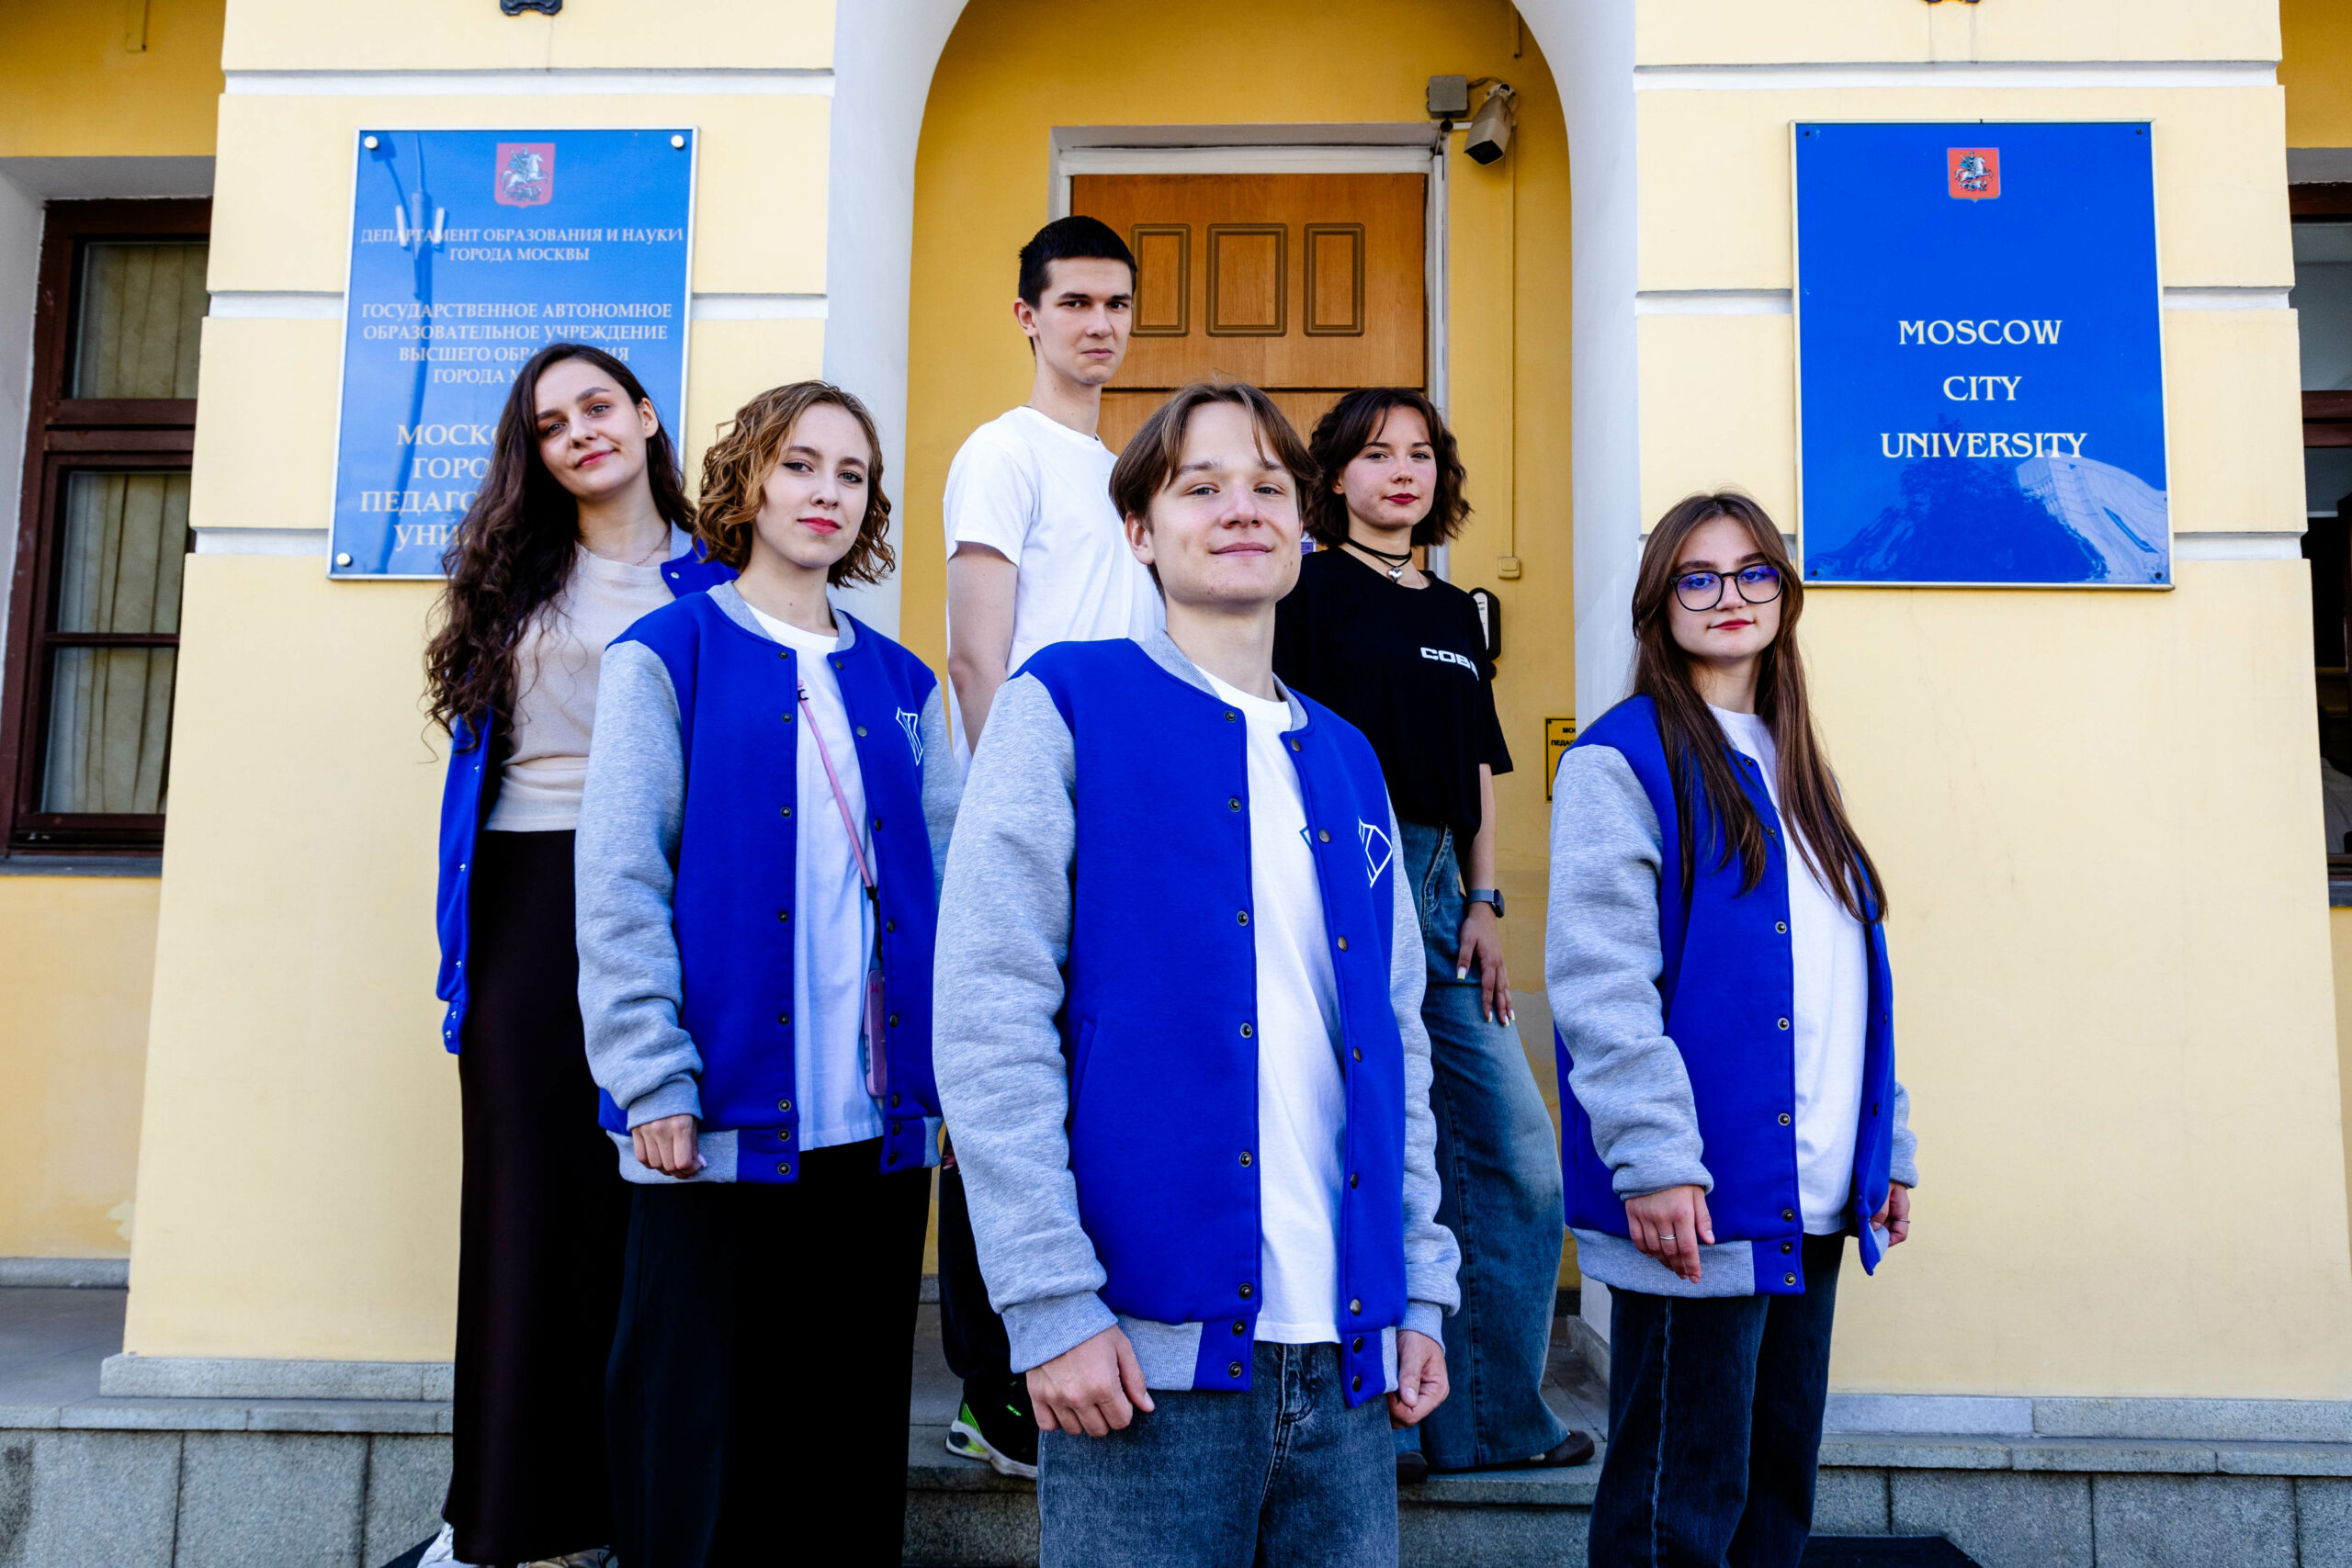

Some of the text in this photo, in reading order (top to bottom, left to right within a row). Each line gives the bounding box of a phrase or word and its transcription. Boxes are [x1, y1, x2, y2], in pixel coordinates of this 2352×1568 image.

[361, 228, 684, 244] ДЕПАРТАМЕНТ ОБРАЗОВАНИЯ И НАУКИ
[449, 248, 590, 263] ГОРОДА МОСКВЫ
[362, 303, 673, 321] ГОСУДАРСТВЕННОЕ АВТОНОМНОЕ
[363, 325, 668, 344] ОБРАЗОВАТЕЛЬНОЕ УЧРЕЖДЕНИЕ
[1898, 320, 2063, 345] MOSCOW
[399, 346, 491, 361] ВЫСШЕГО
[434, 368, 505, 385] ГОРОДА
[1942, 376, 2022, 401] CITY
[396, 424, 499, 446] МОСК
[1881, 432, 2088, 458] UNIVERSITY
[413, 457, 492, 479] ГОРО
[359, 491, 480, 516] ПЕДАГО
[394, 525, 469, 551] УНИ
